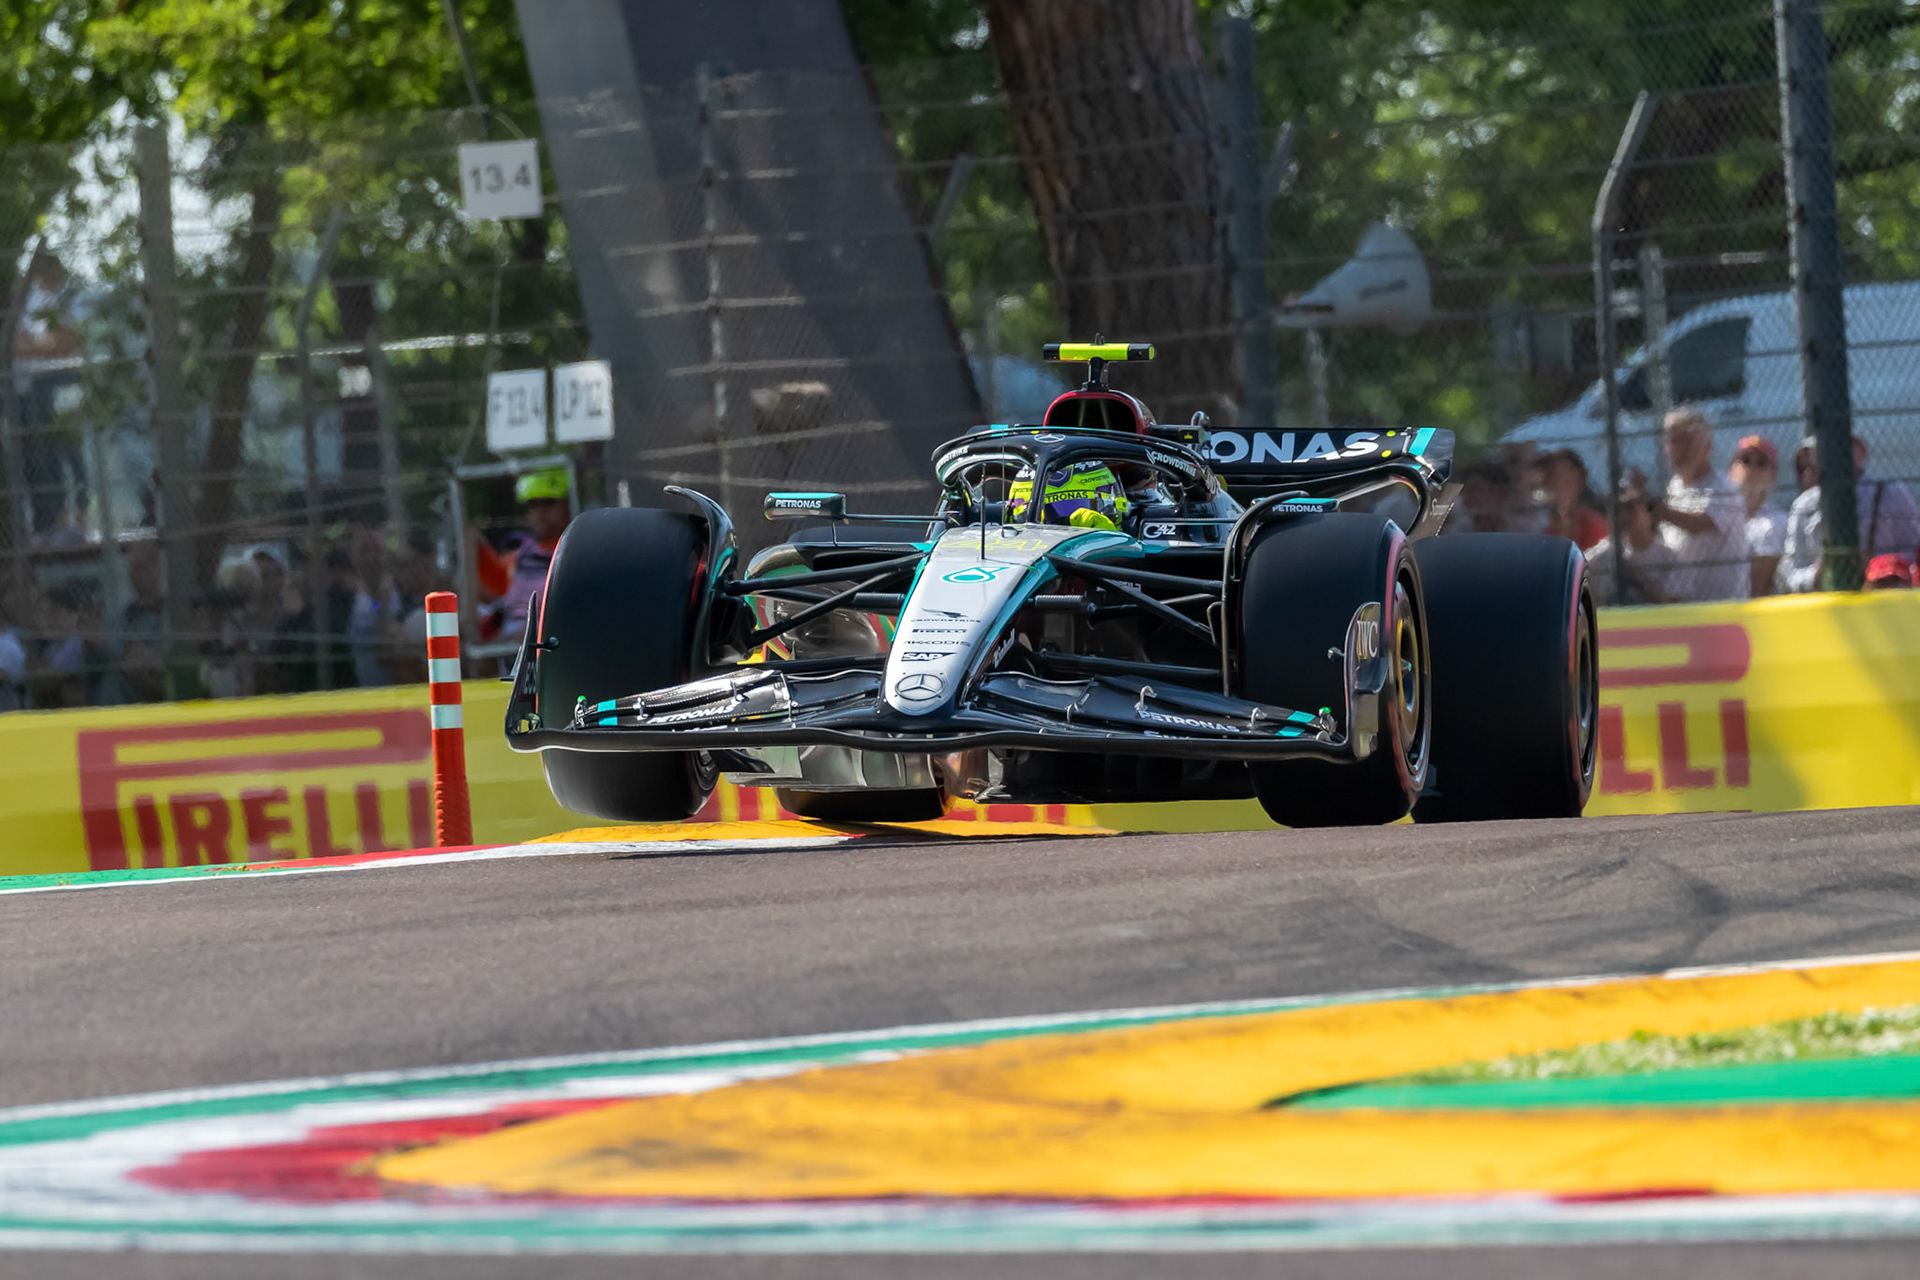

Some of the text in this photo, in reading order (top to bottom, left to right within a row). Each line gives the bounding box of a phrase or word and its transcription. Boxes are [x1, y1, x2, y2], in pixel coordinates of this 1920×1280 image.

[468, 163, 531, 194] 13.4
[1203, 431, 1380, 463] ONAS
[1151, 450, 1196, 477] CROWDSTRIKE
[775, 500, 822, 509] PETRONAS
[1046, 491, 1088, 502] TRONAS
[1272, 504, 1323, 512] PETRONAS
[1143, 524, 1176, 538] G42
[1356, 621, 1378, 657] IWC
[647, 705, 735, 724] PETRONAS
[1140, 710, 1240, 733] PETRONAS
[78, 708, 433, 871] PIRELLI
